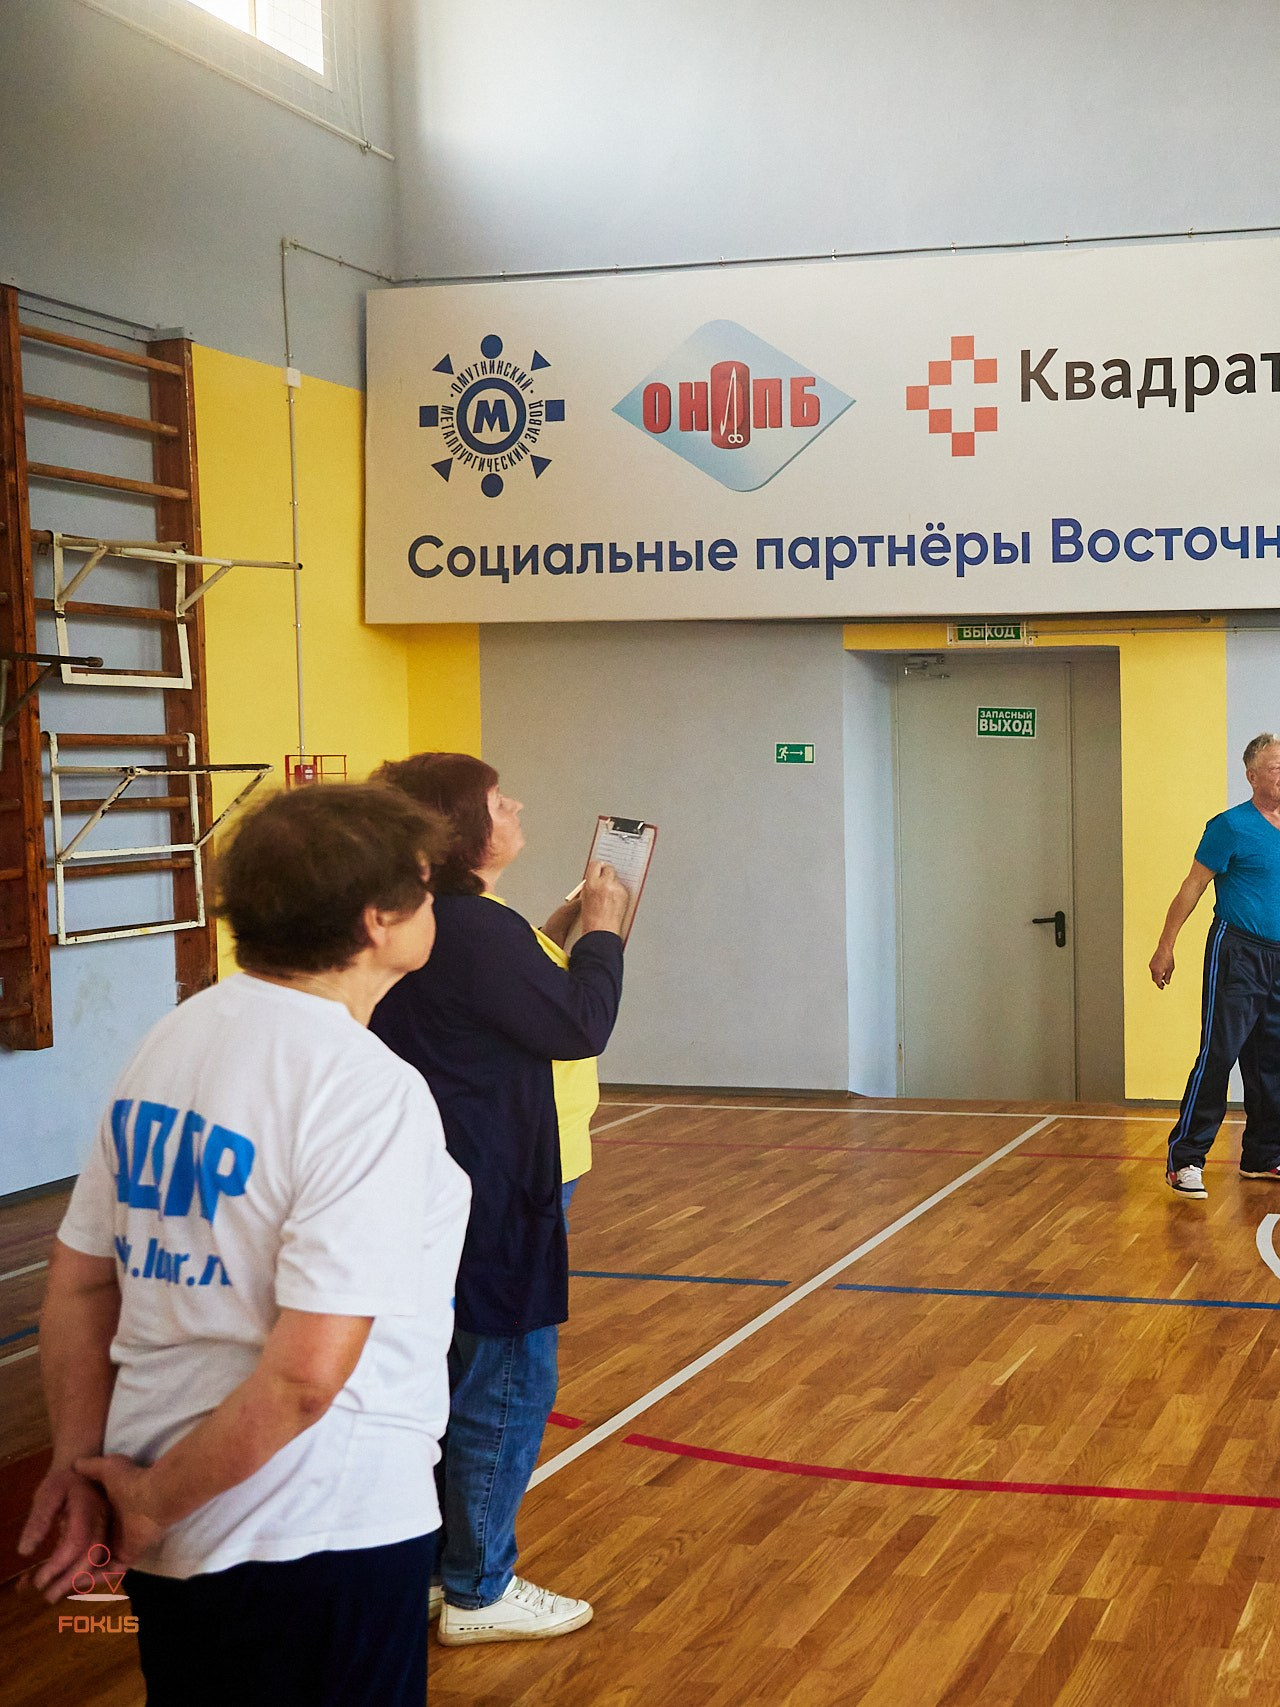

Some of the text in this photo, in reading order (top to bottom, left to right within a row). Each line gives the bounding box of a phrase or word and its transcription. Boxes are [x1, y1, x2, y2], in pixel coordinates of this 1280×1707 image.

[449, 359, 535, 394] ОМУТНИНСКИЙ
[472, 398, 510, 434] М
[440, 399, 544, 473] МЕТАЛЛУРГИЧЕСКИЙ ЗАВОД
[408, 534, 738, 583] Социальные
[756, 521, 1031, 581] партнёры
[962, 626, 1015, 638] ВЫХОД
[980, 710, 1033, 719] ЗАПАСНЫЙ
[980, 718, 1033, 736] ВЫХОД
